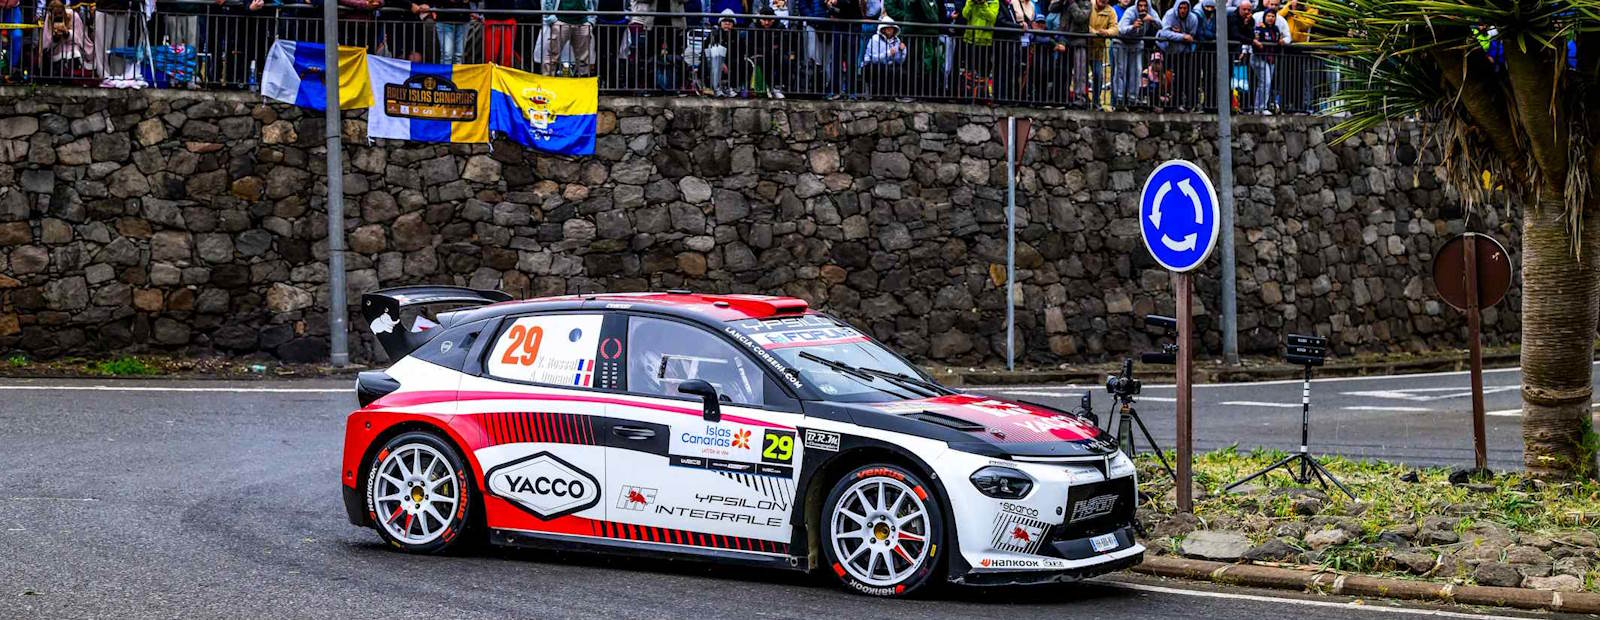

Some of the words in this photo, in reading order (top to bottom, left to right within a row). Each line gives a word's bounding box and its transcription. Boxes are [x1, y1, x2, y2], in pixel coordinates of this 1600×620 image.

[387, 86, 407, 100] RALLY
[408, 88, 432, 103] ISLAS
[433, 90, 474, 105] CANARIAS
[501, 324, 544, 366] 29
[681, 432, 730, 448] Canarias
[706, 425, 731, 437] Islas
[762, 433, 793, 461] 29
[504, 474, 585, 499] YACCO
[695, 493, 788, 512] YPSILON
[1002, 502, 1039, 518] sparco
[655, 504, 783, 528] INTEGRALE
